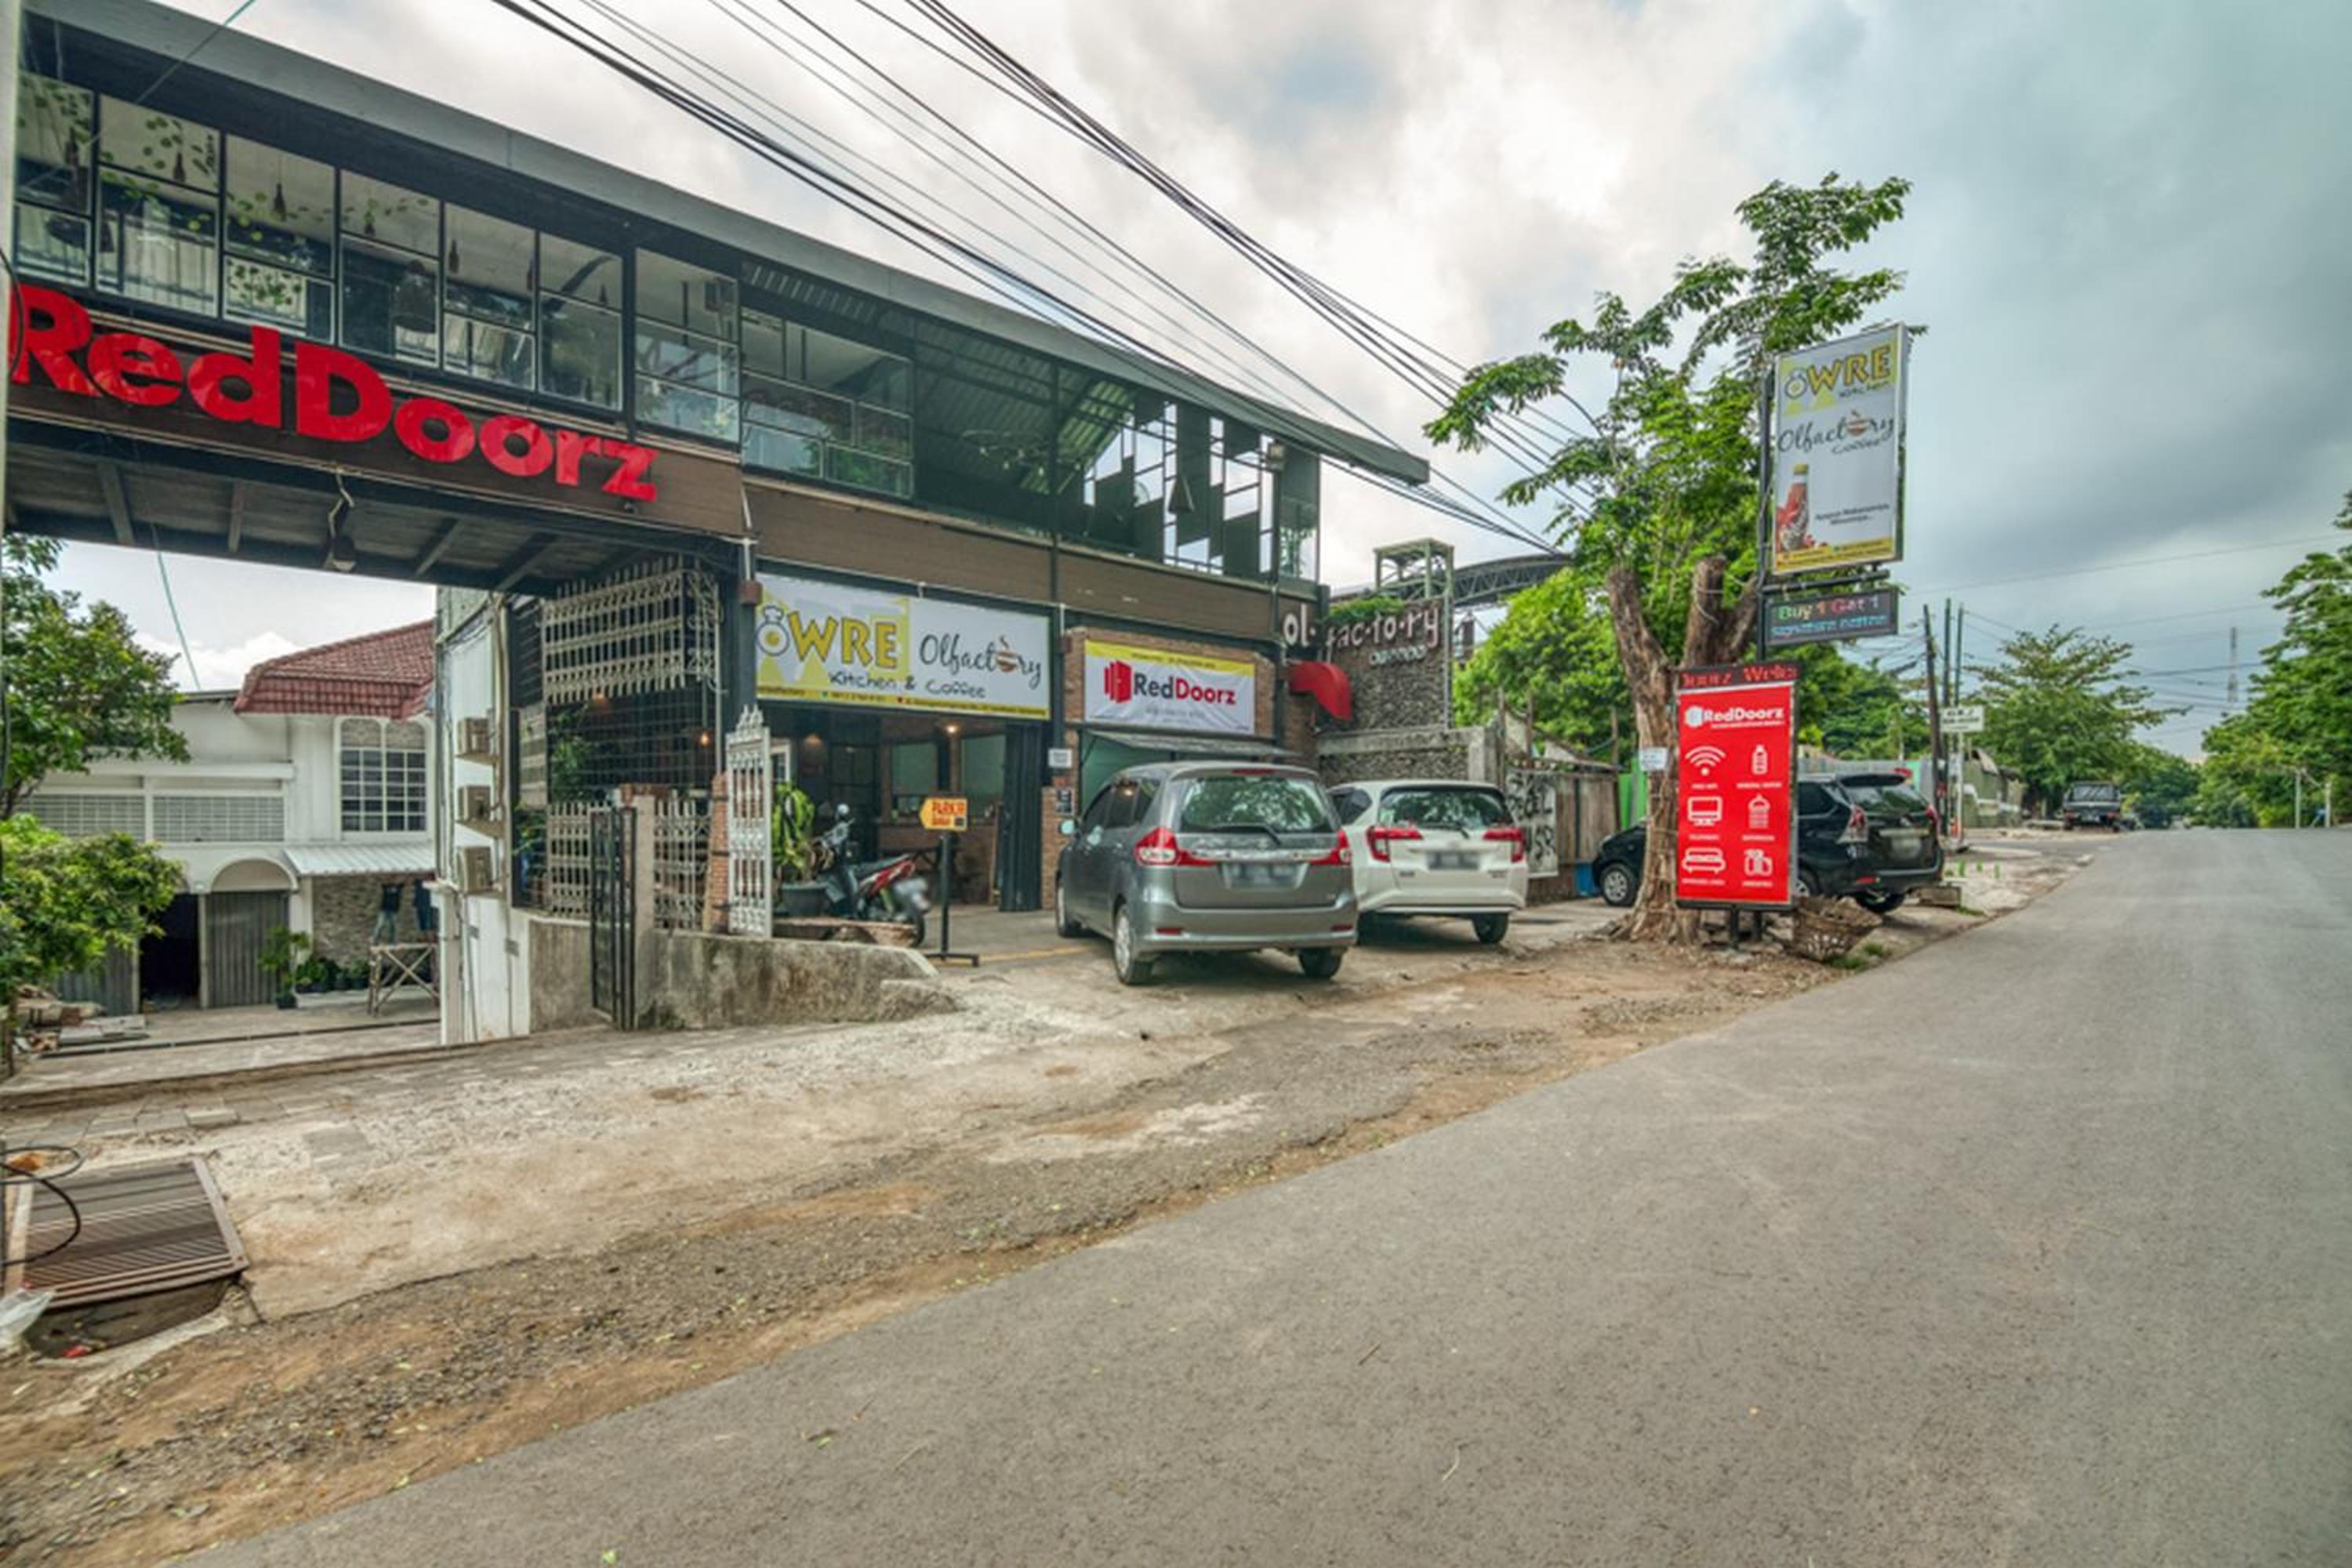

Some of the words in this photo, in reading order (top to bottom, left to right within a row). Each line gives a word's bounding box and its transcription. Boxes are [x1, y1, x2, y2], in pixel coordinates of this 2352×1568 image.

[9, 283, 657, 502] RedDoorz
[1778, 604, 1813, 621] Buy
[829, 670, 897, 689] Kitchen
[904, 675, 916, 691] &
[1134, 672, 1236, 705] RedDoorz
[1704, 707, 1784, 723] RedDoorz
